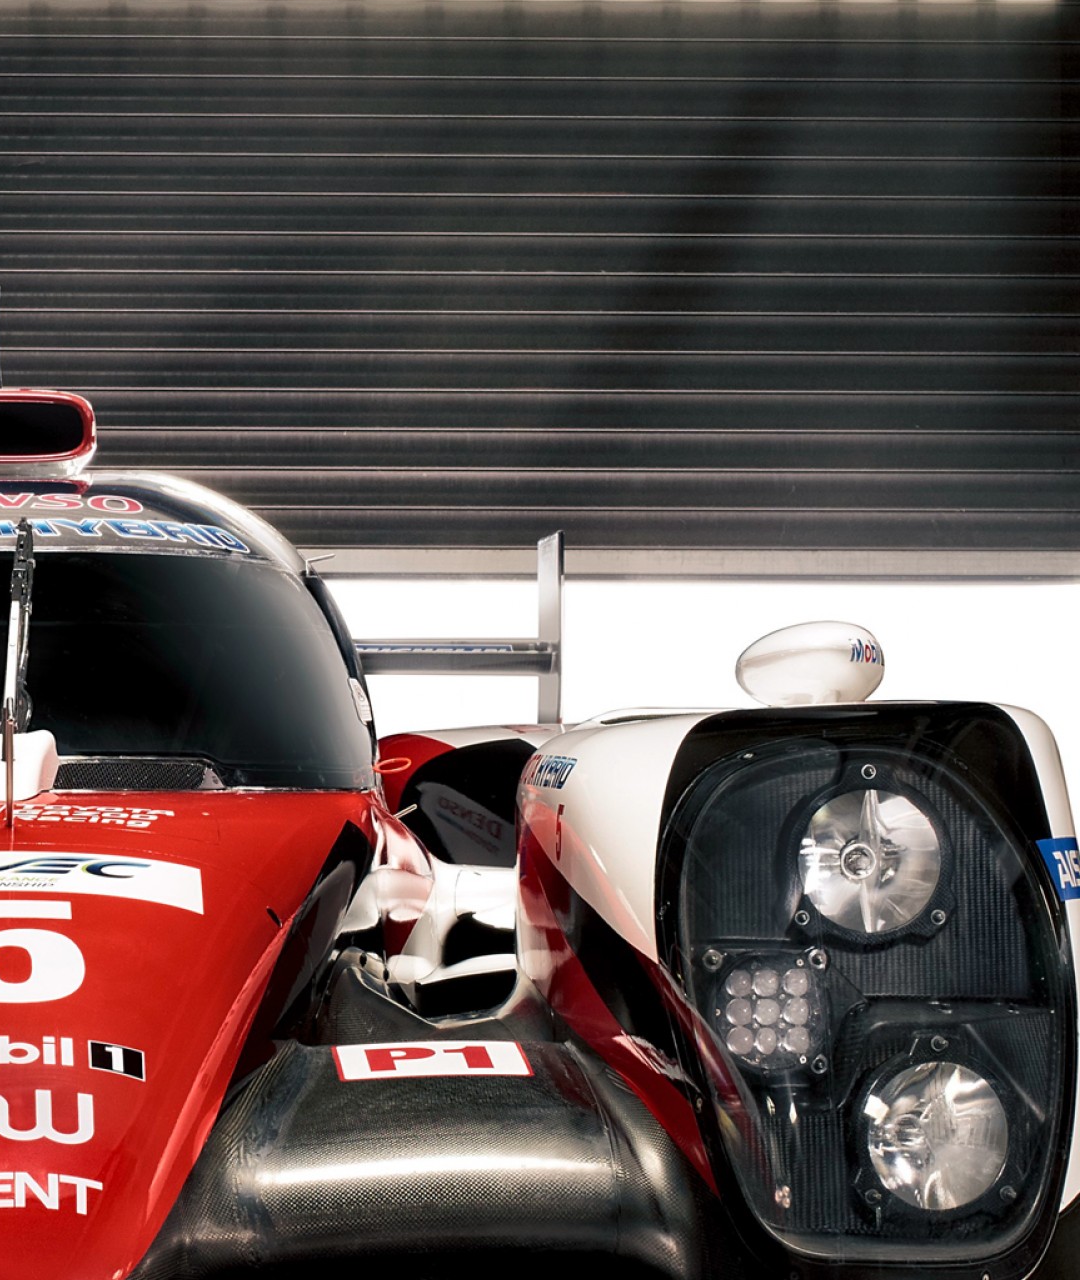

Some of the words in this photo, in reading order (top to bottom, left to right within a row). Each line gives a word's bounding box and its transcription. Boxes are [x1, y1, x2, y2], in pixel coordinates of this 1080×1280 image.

[15, 803, 175, 817] TOYOTA
[555, 803, 565, 861] 5
[364, 1045, 495, 1073] P1
